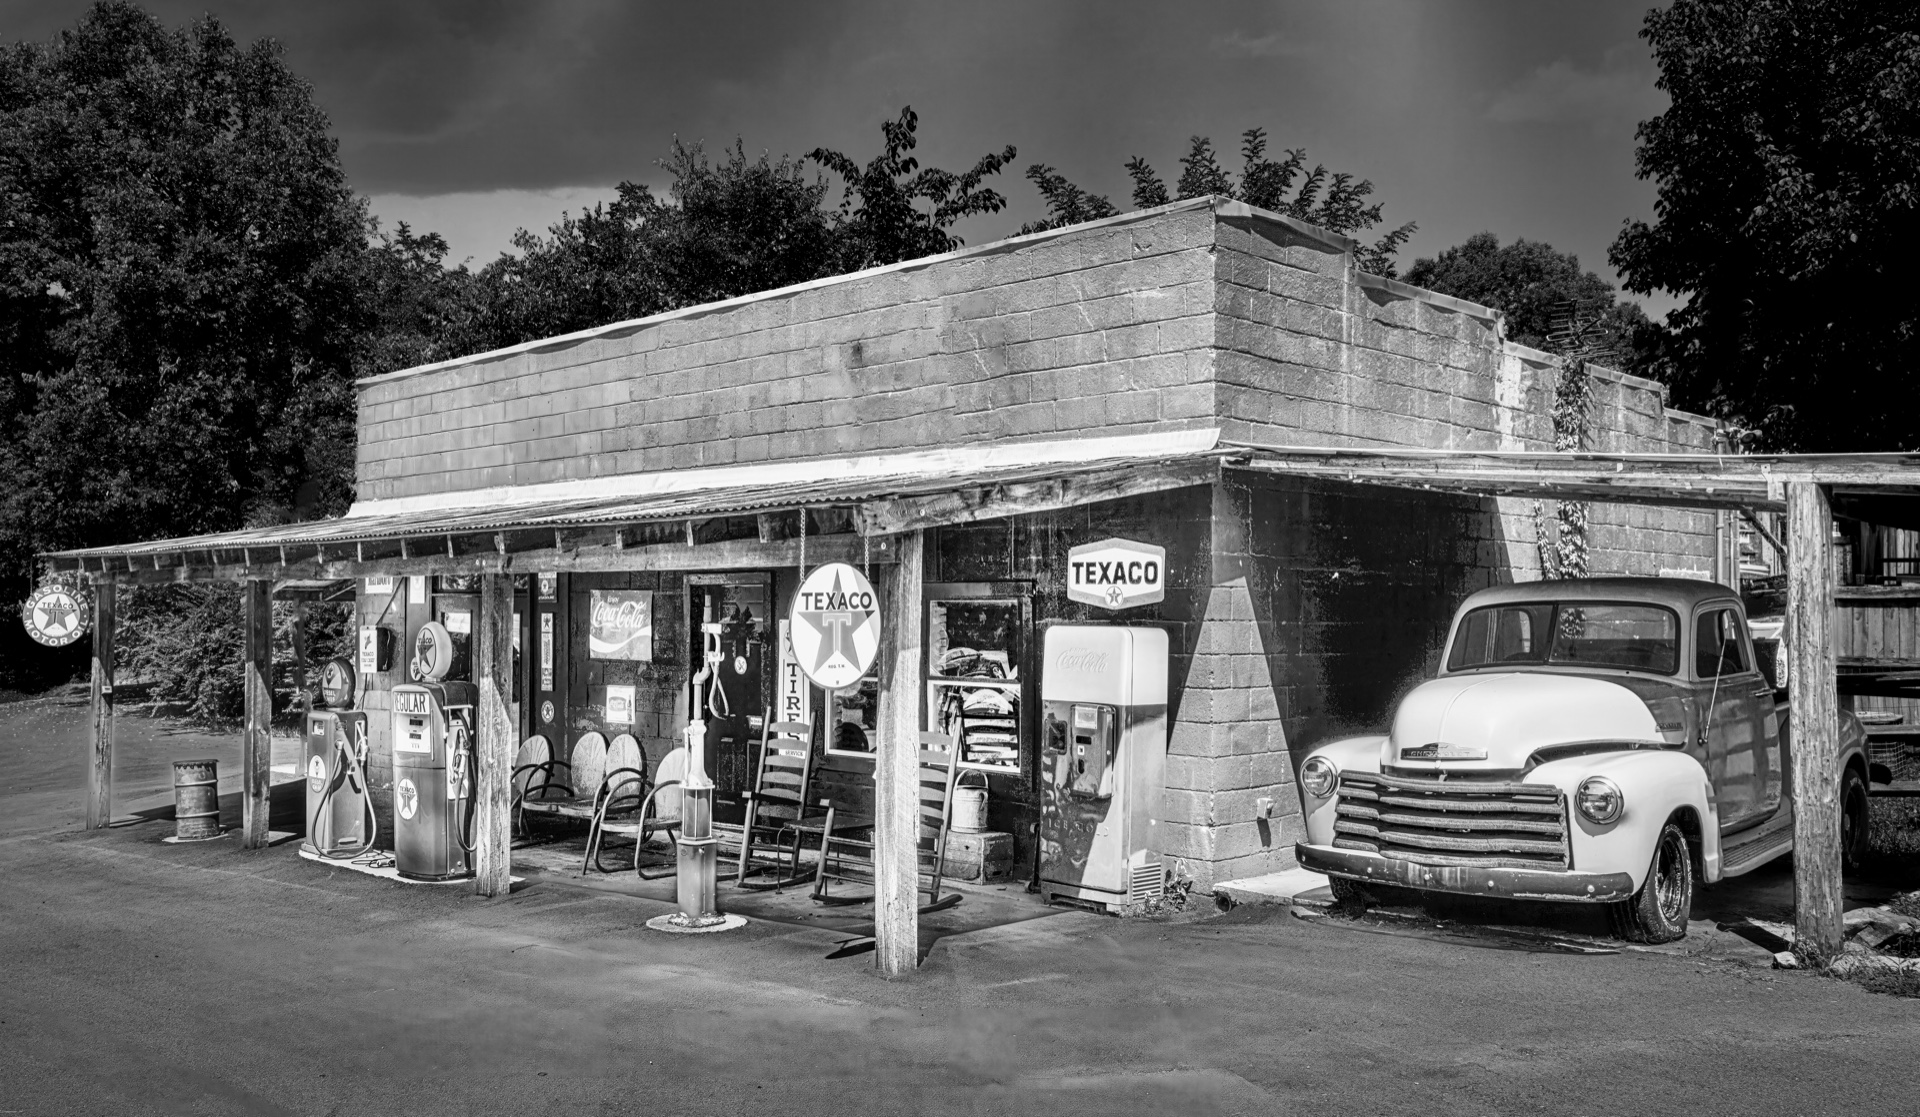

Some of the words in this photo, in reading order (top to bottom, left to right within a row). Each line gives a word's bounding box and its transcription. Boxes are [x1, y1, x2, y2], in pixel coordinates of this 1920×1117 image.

[1071, 561, 1159, 585] TEXACO
[26, 584, 89, 611] GASOLINE
[42, 602, 74, 610] TEXACO
[801, 591, 873, 611] TEXACO
[24, 619, 69, 646] MOTOR
[72, 620, 88, 639] OIL
[400, 785, 415, 794] TEXACO
